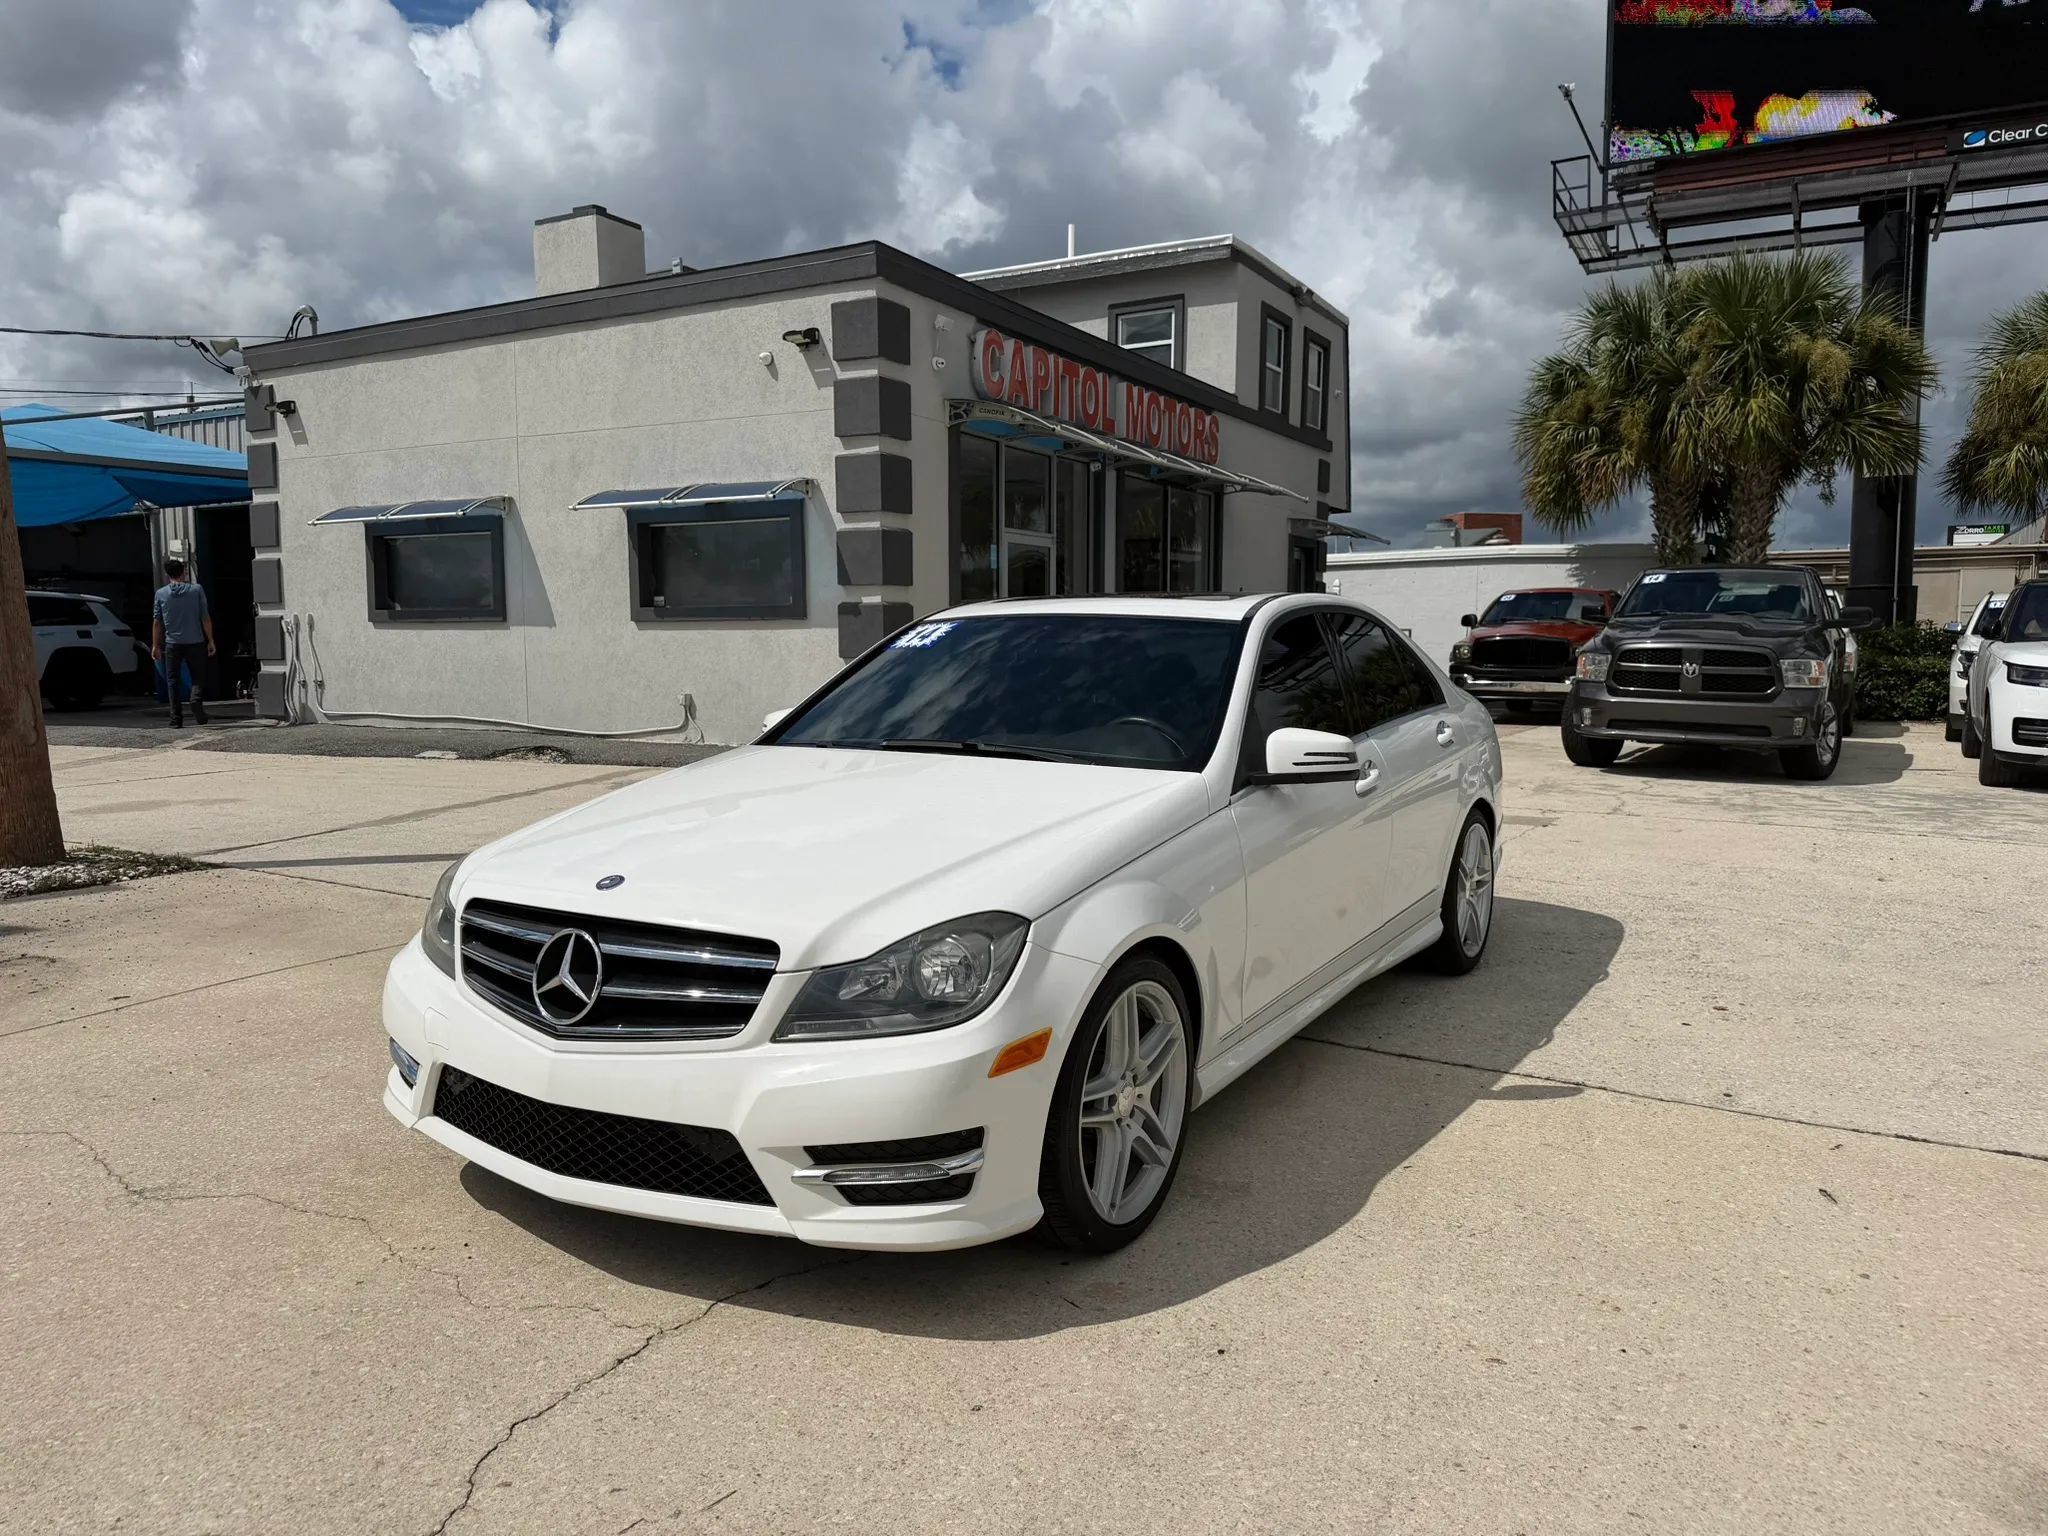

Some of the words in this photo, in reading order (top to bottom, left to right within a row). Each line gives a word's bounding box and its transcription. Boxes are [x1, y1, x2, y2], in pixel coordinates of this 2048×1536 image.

[1988, 128, 2033, 143] Clear
[980, 328, 1115, 434] CAPITOL
[1124, 382, 1220, 466] MOTORS
